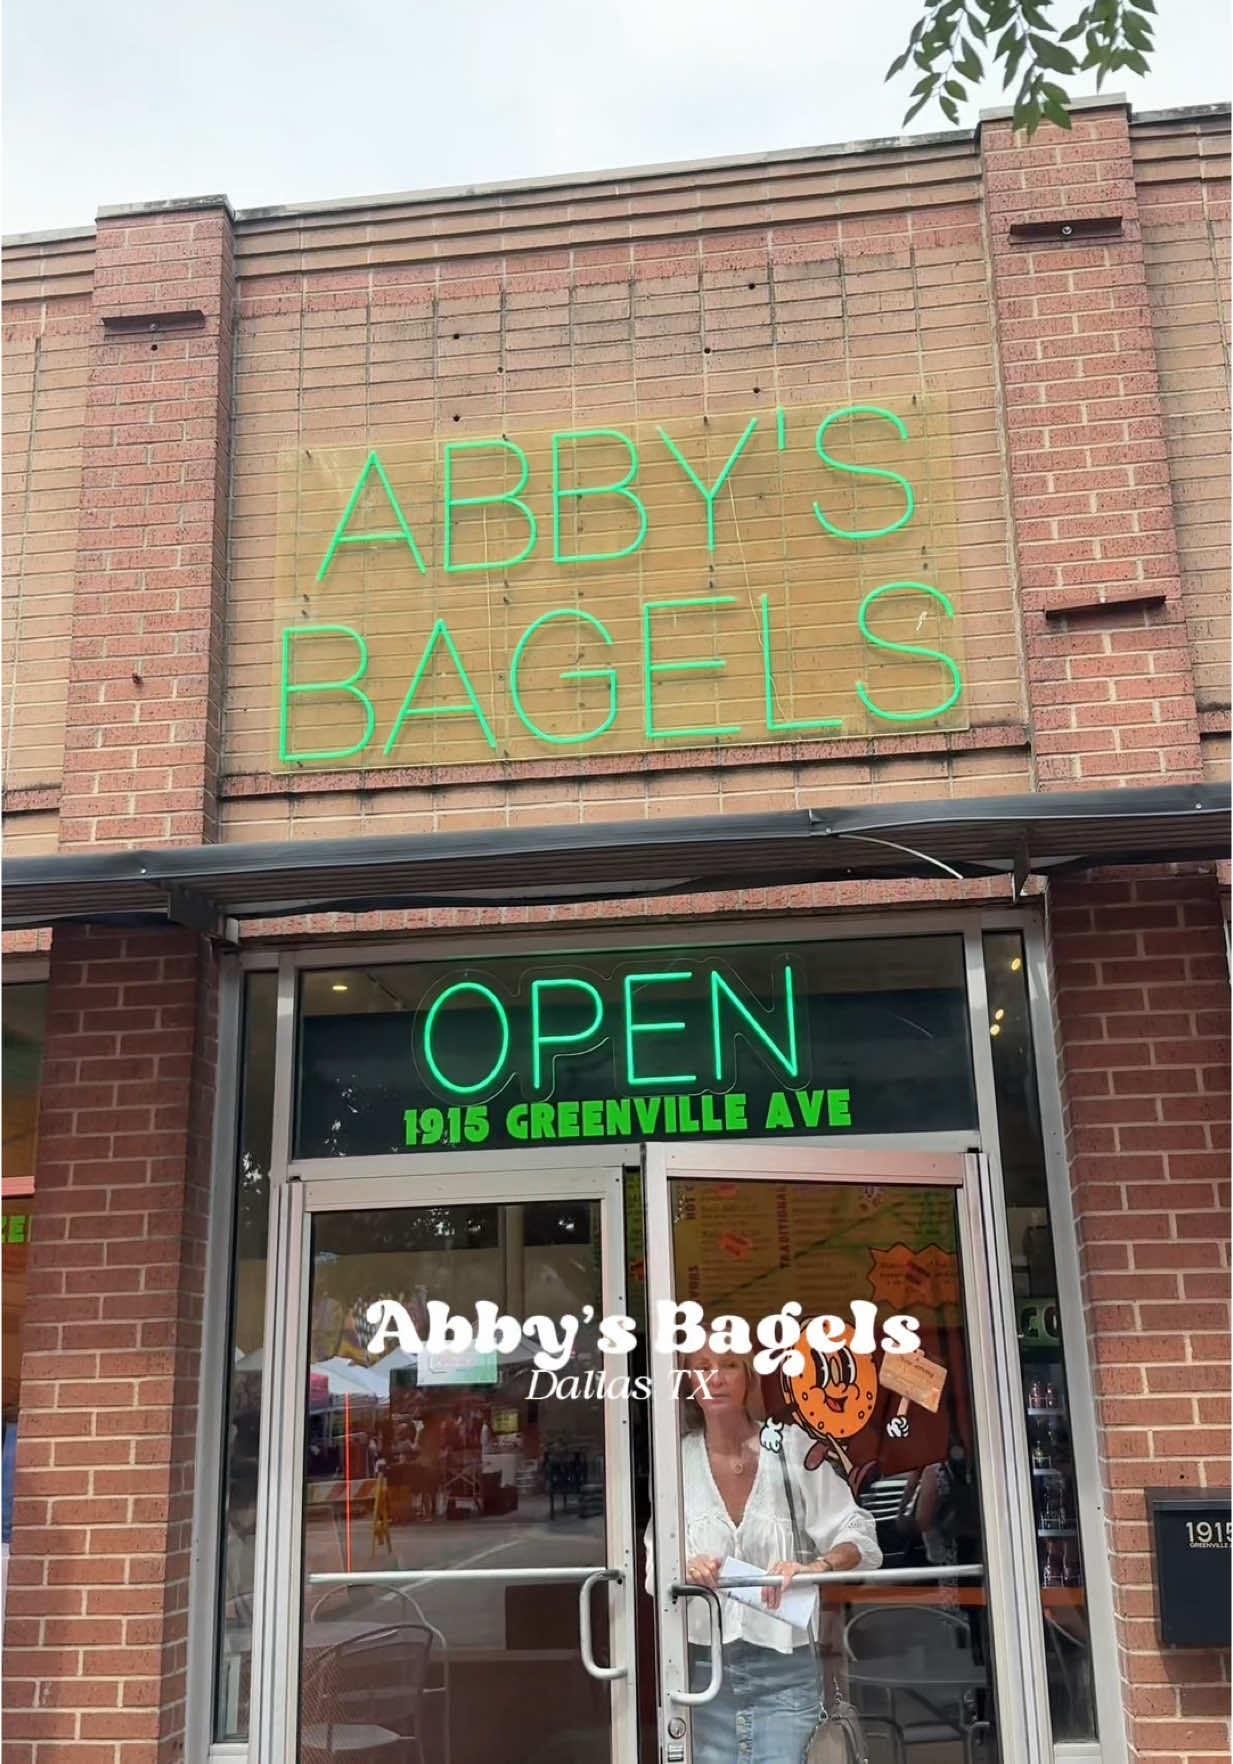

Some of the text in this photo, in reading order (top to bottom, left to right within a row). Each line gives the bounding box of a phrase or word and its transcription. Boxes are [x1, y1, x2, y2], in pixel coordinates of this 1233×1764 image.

[318, 405, 916, 581] ABBY'S
[278, 581, 963, 763] BAGELS
[423, 966, 799, 1095] OPEN
[403, 1088, 852, 1145] 1915 GREENVILLE AVE
